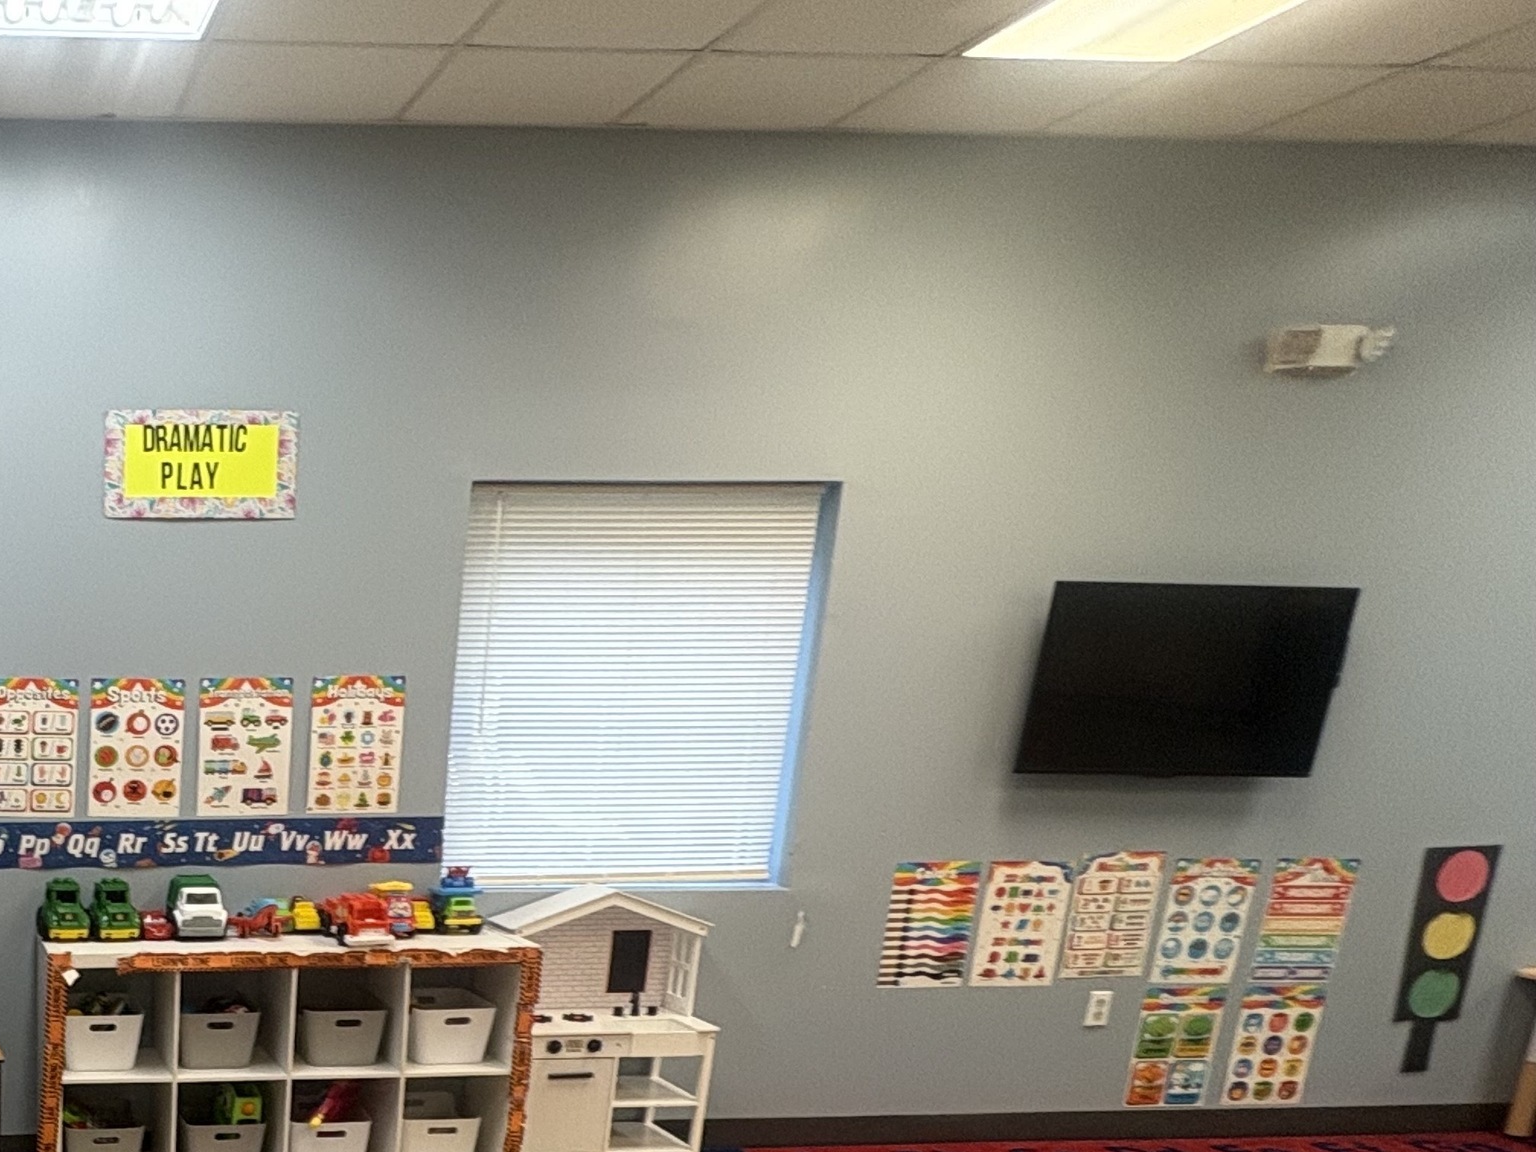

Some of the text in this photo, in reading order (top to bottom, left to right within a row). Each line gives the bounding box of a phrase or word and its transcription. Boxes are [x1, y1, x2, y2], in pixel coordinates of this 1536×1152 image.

[142, 424, 248, 452] DRAMATIC
[161, 462, 219, 490] PLAY
[107, 685, 167, 703] Sports
[18, 835, 50, 858] Pp
[67, 833, 101, 858] Qq
[117, 833, 147, 854] Rr
[161, 833, 188, 854] Ss
[194, 832, 219, 853] Tt
[232, 832, 264, 852] Uu
[281, 830, 311, 851] Vv
[324, 830, 369, 851] Ww
[384, 829, 416, 850] Xx
